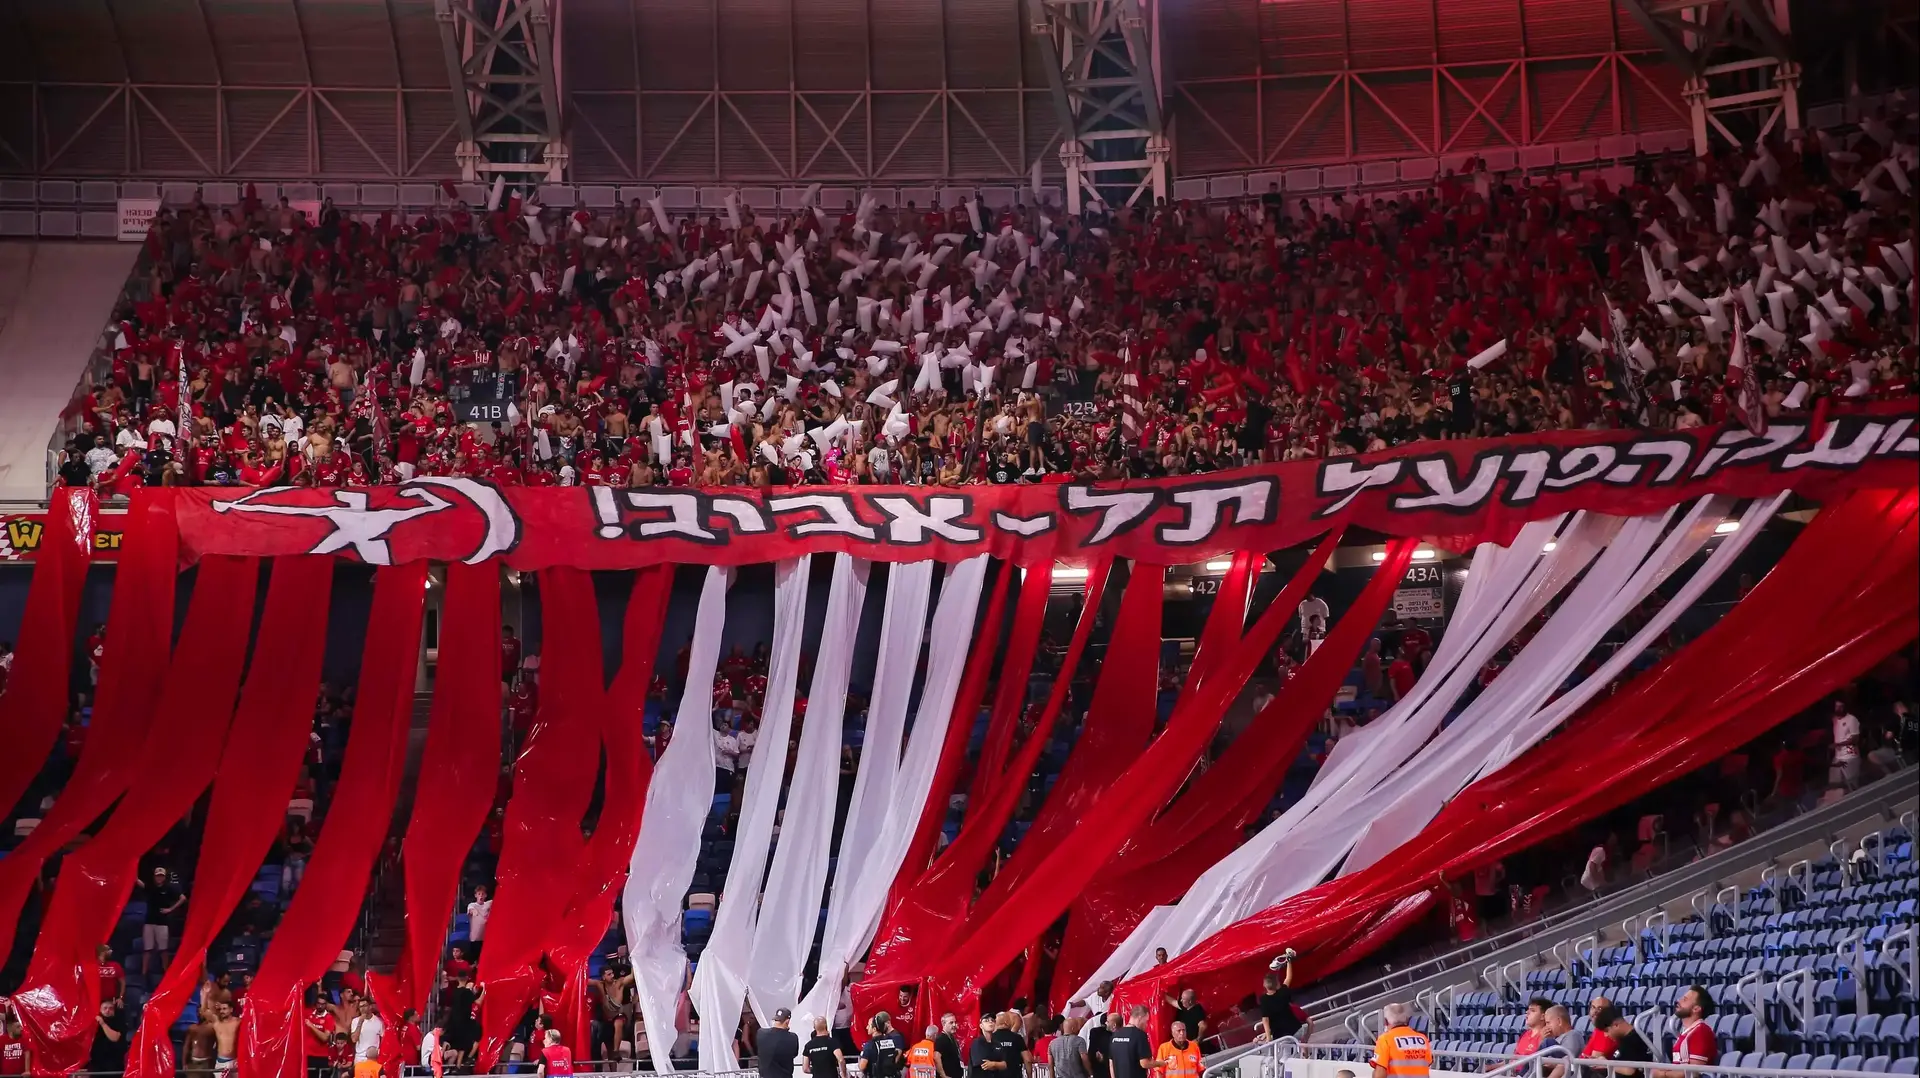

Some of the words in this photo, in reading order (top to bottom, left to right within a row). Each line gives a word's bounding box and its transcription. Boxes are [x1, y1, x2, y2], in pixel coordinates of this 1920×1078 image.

[469, 405, 502, 419] 41B
[1320, 437, 1694, 519] הפועל
[1406, 567, 1440, 582] 43A
[1396, 1036, 1426, 1048] סדרן
